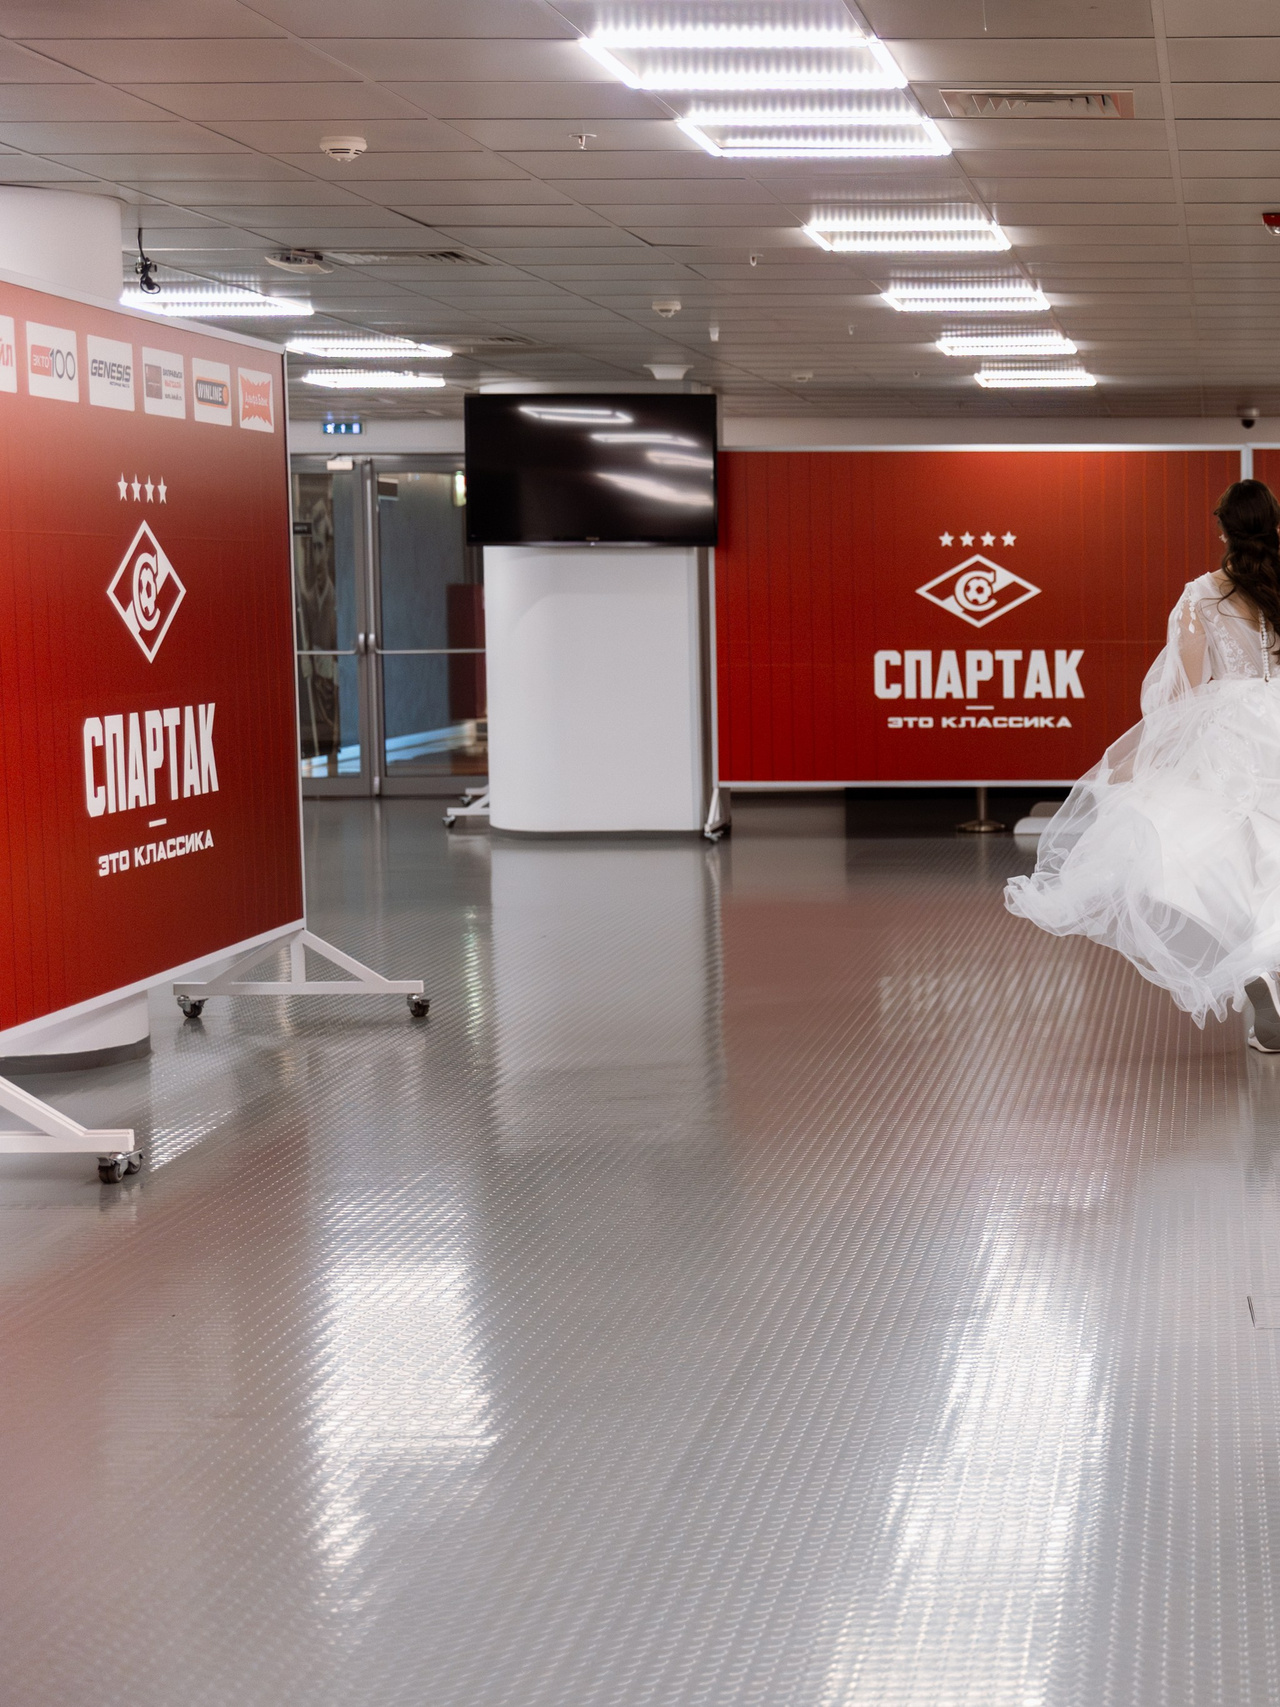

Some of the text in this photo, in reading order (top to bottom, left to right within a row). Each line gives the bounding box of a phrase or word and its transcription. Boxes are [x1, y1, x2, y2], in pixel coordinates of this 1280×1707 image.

[91, 359, 131, 382] GENESIS
[197, 383, 222, 402] WINLINE
[873, 649, 1085, 699] СПАРТАК
[887, 716, 1072, 728] ЭТО КЛАССИКА
[83, 702, 219, 818] СПАРТАК
[98, 829, 214, 877] ЭТО КЛАССИКА
